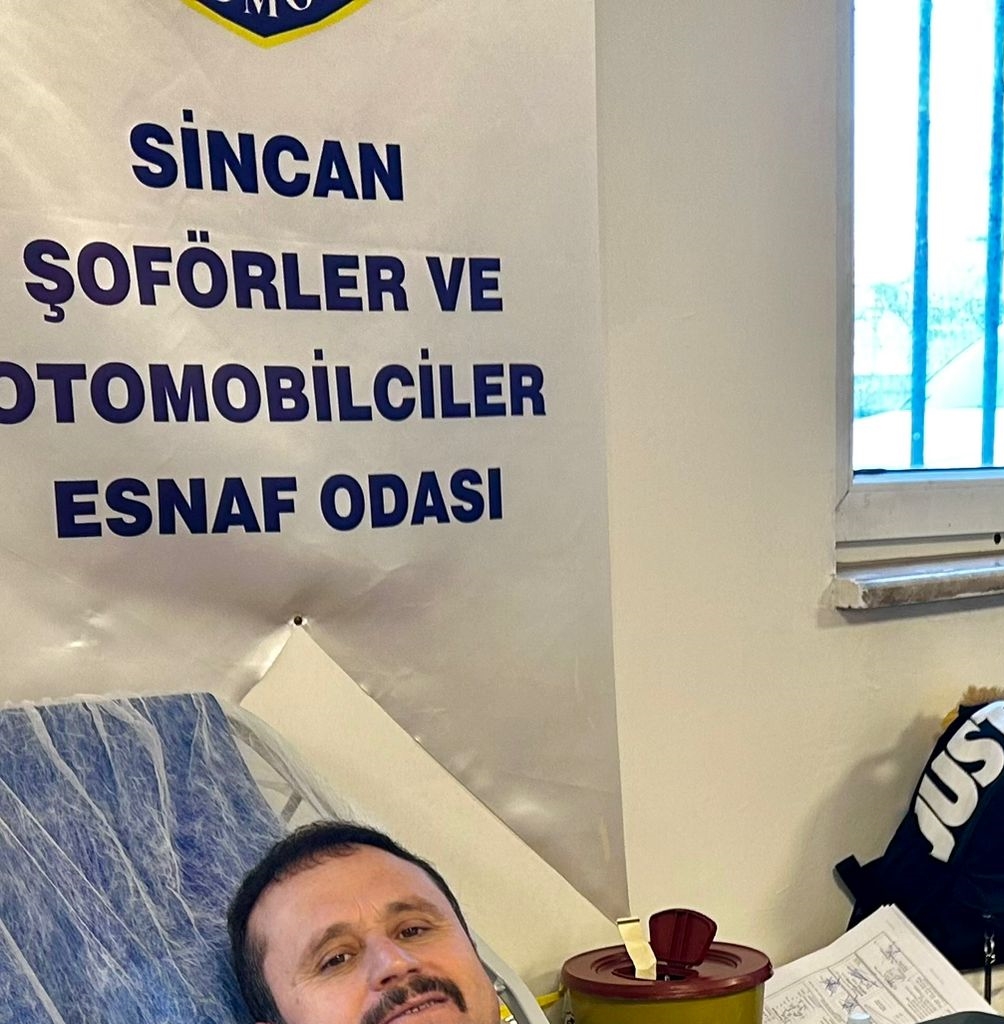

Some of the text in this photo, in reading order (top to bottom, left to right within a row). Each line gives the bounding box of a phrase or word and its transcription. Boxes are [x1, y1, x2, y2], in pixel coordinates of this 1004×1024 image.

[129, 108, 405, 202] SİNCAN
[23, 229, 504, 324] ŞOFÖRLER VE
[0, 347, 548, 425] OTOMOBİLCİLER
[53, 467, 504, 539] ESNAF ODASI
